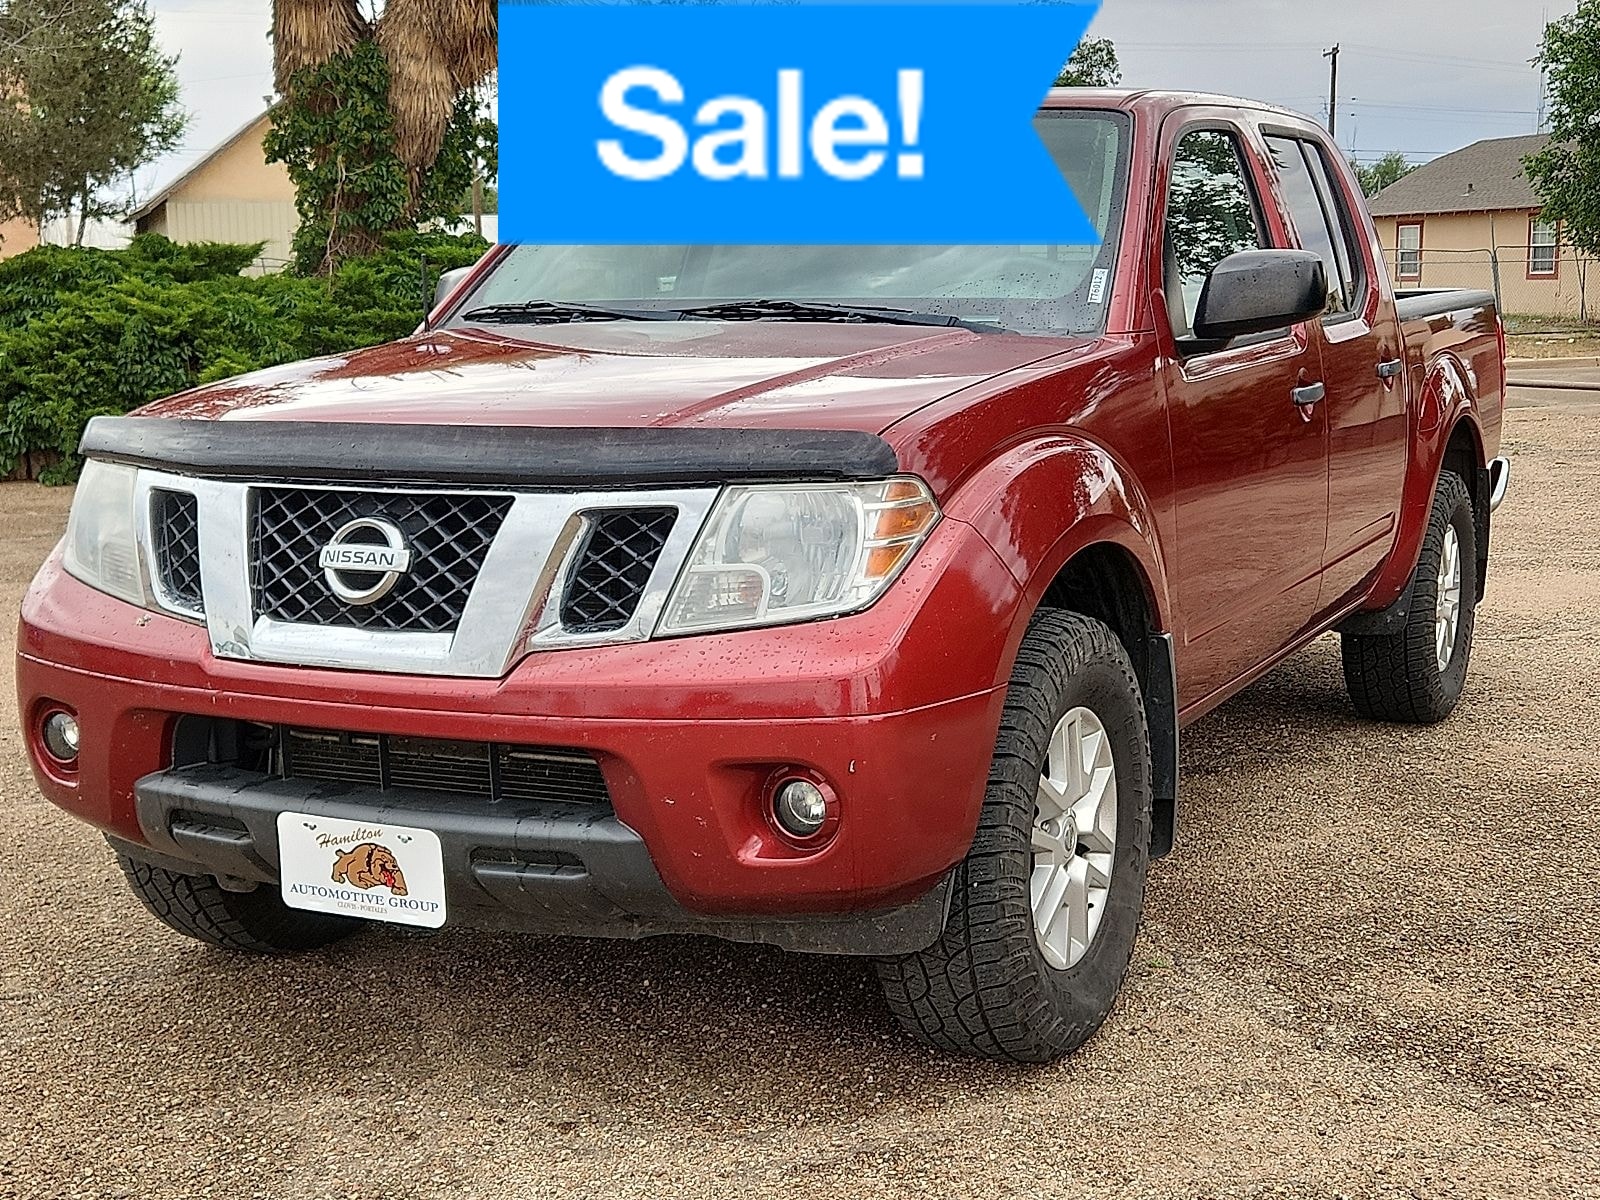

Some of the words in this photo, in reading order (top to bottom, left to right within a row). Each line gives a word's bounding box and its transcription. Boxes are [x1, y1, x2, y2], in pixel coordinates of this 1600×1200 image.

[324, 549, 395, 566] NISSAN
[315, 827, 384, 849] Hamilton
[290, 883, 386, 906] AUTOMOTIVE
[389, 897, 439, 913] GROUP
